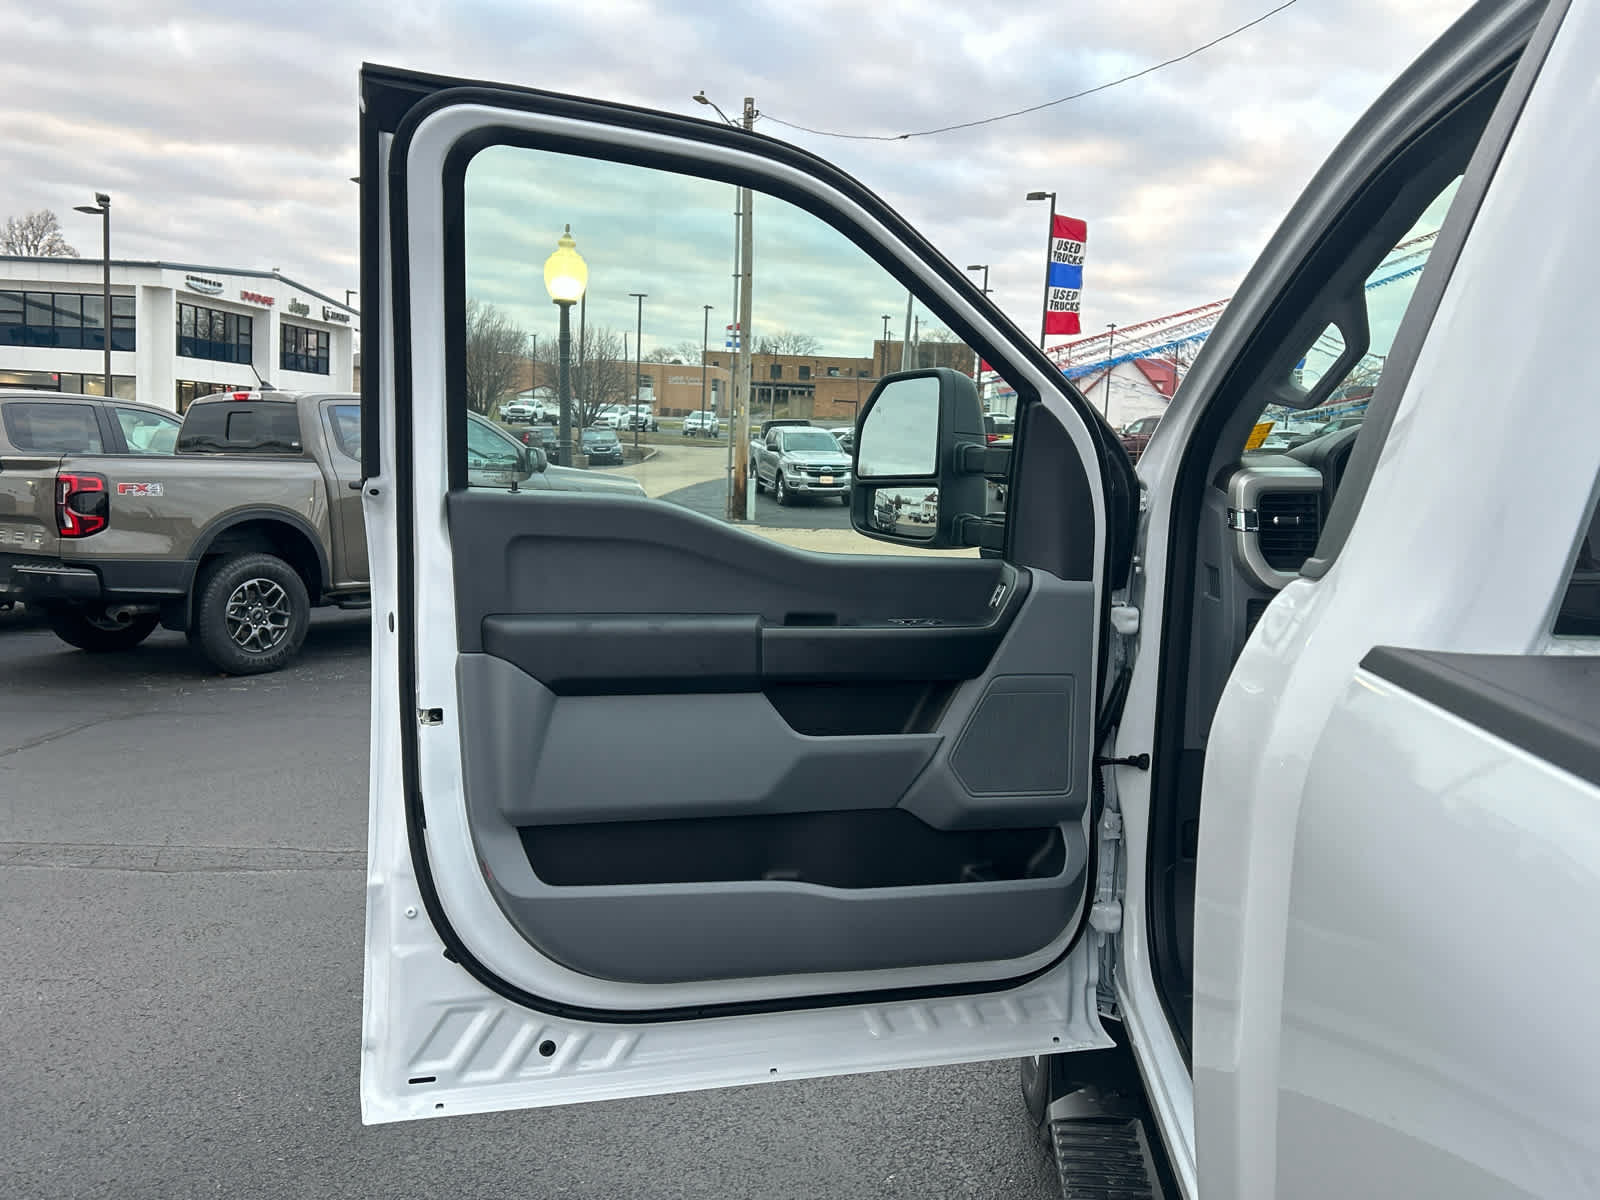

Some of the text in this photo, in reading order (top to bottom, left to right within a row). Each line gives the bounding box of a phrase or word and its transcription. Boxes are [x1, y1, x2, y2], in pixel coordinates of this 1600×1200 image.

[1056, 239, 1081, 254] USED
[1053, 250, 1084, 265] TRUCKS
[1052, 288, 1078, 301] USED
[1049, 300, 1080, 312] TRUCKS
[117, 482, 163, 496] FX4
